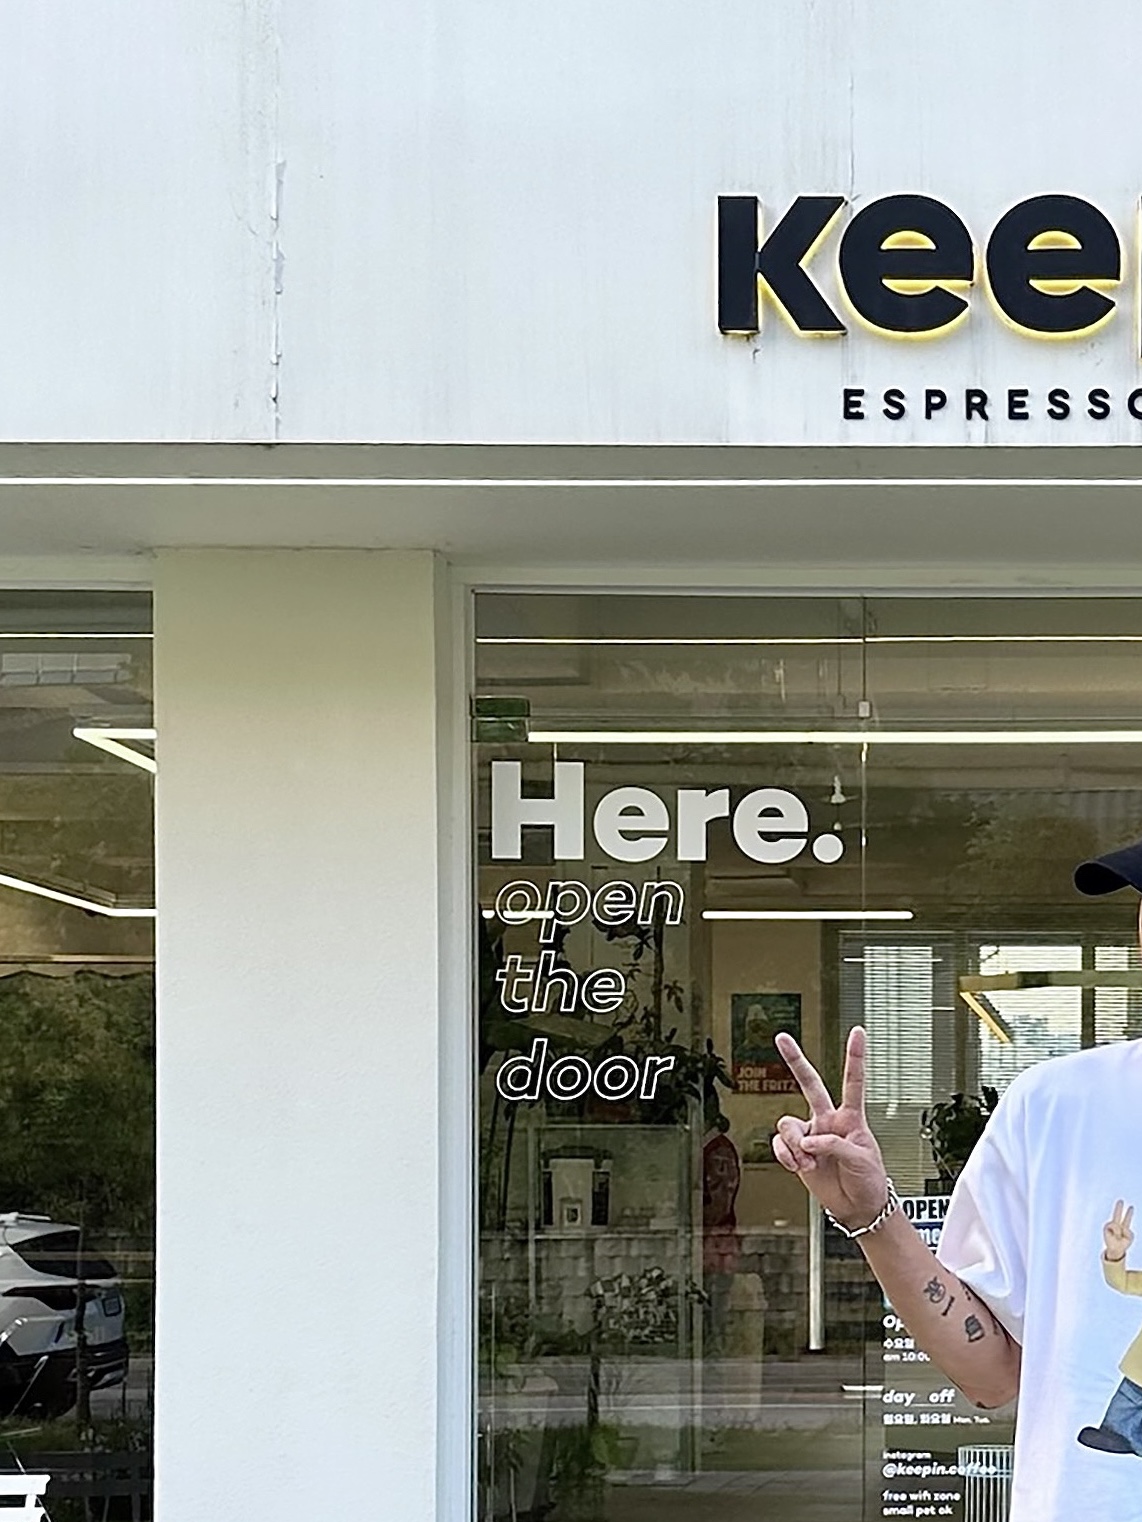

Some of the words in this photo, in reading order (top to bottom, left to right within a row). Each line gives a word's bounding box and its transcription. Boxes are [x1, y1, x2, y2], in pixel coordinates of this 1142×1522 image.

[491, 760, 844, 864] Here.
[495, 880, 686, 943] open
[495, 949, 627, 1013] the
[496, 1038, 675, 1101] door
[737, 1067, 767, 1079] JOIN
[738, 1080, 760, 1092] THE
[903, 1199, 950, 1219] OPEN
[883, 1389, 916, 1407] day
[929, 1389, 956, 1403] off
[882, 1462, 998, 1478] @keepin.coffee
[882, 1490, 907, 1501] free
[933, 1491, 961, 1501] zone
[883, 1505, 914, 1516] small
[916, 1505, 936, 1517] pet
[938, 1505, 954, 1516] ok
